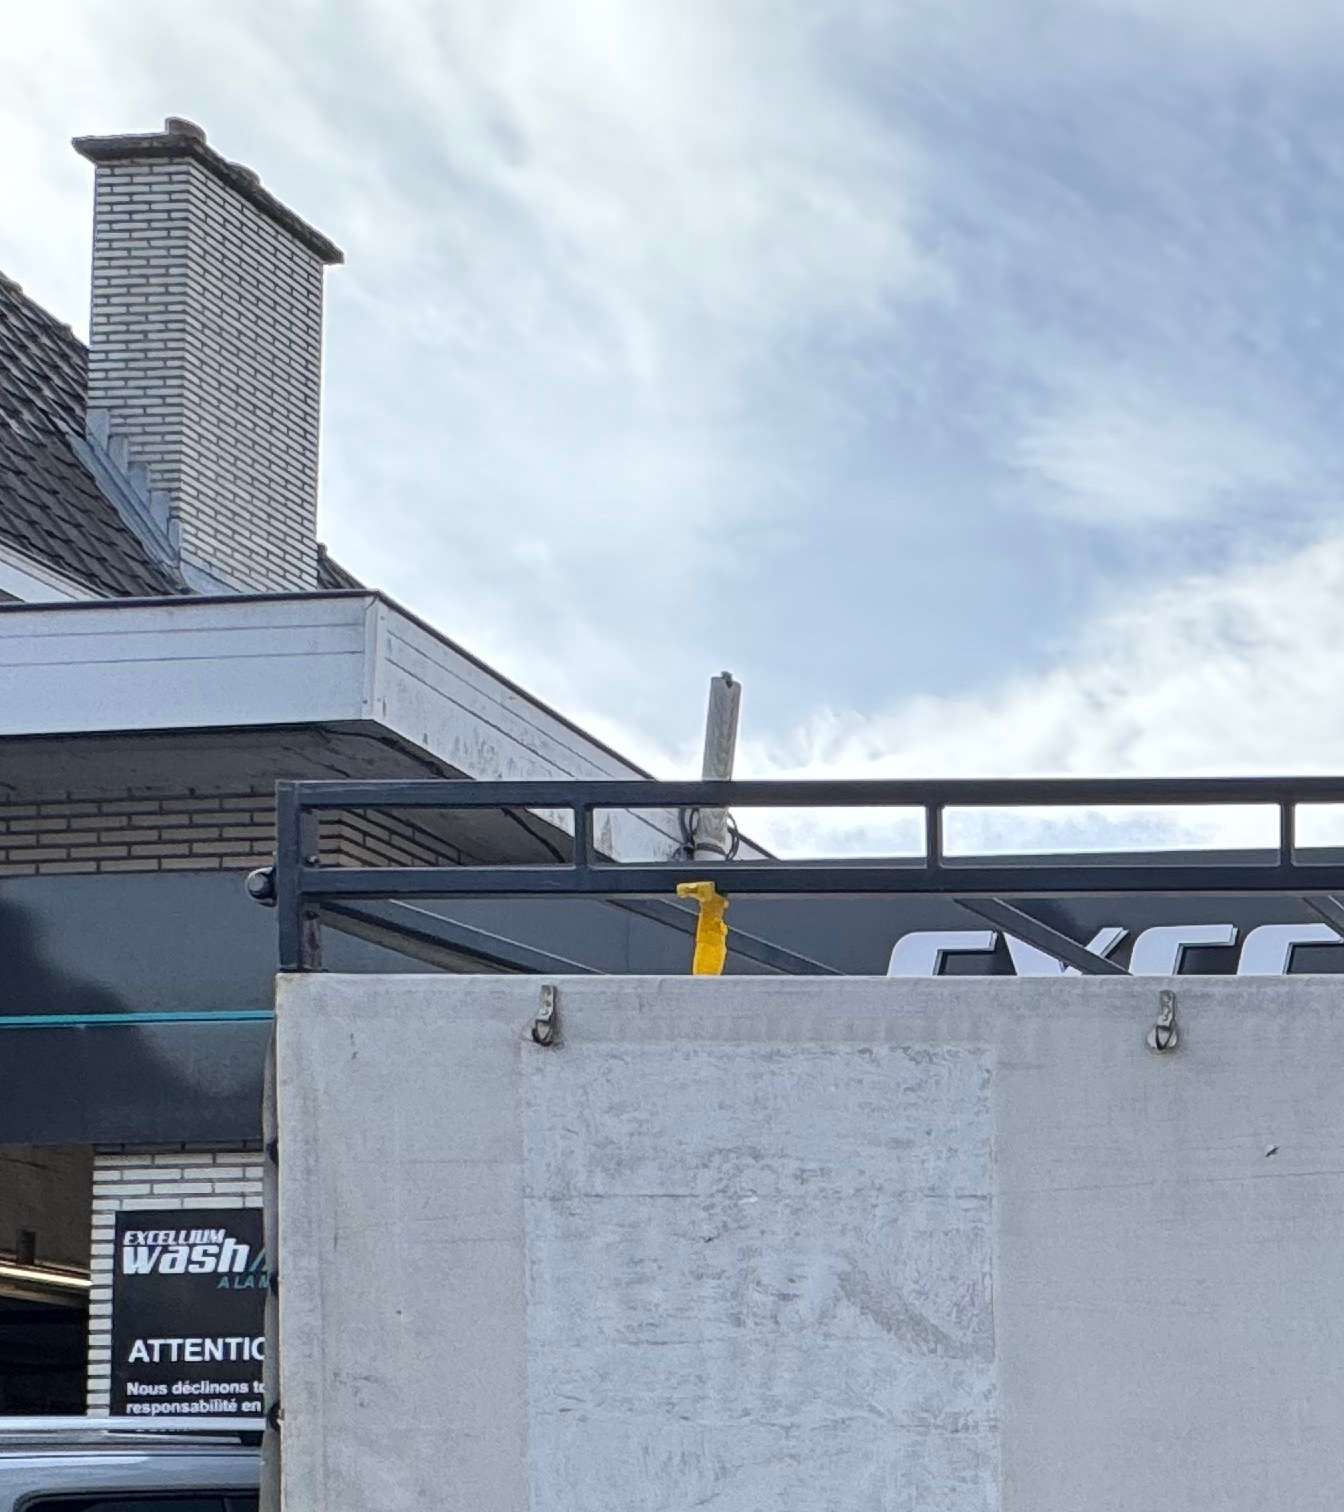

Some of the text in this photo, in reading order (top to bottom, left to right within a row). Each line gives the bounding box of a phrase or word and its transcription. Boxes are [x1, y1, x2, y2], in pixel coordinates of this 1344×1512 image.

[123, 1229, 226, 1246] EXCELLIUM
[123, 1238, 250, 1274] wash
[128, 1337, 265, 1363] ATTENTIO
[127, 1382, 168, 1396] Nous
[171, 1380, 249, 1395] déclinons
[126, 1398, 238, 1416] responsabilité
